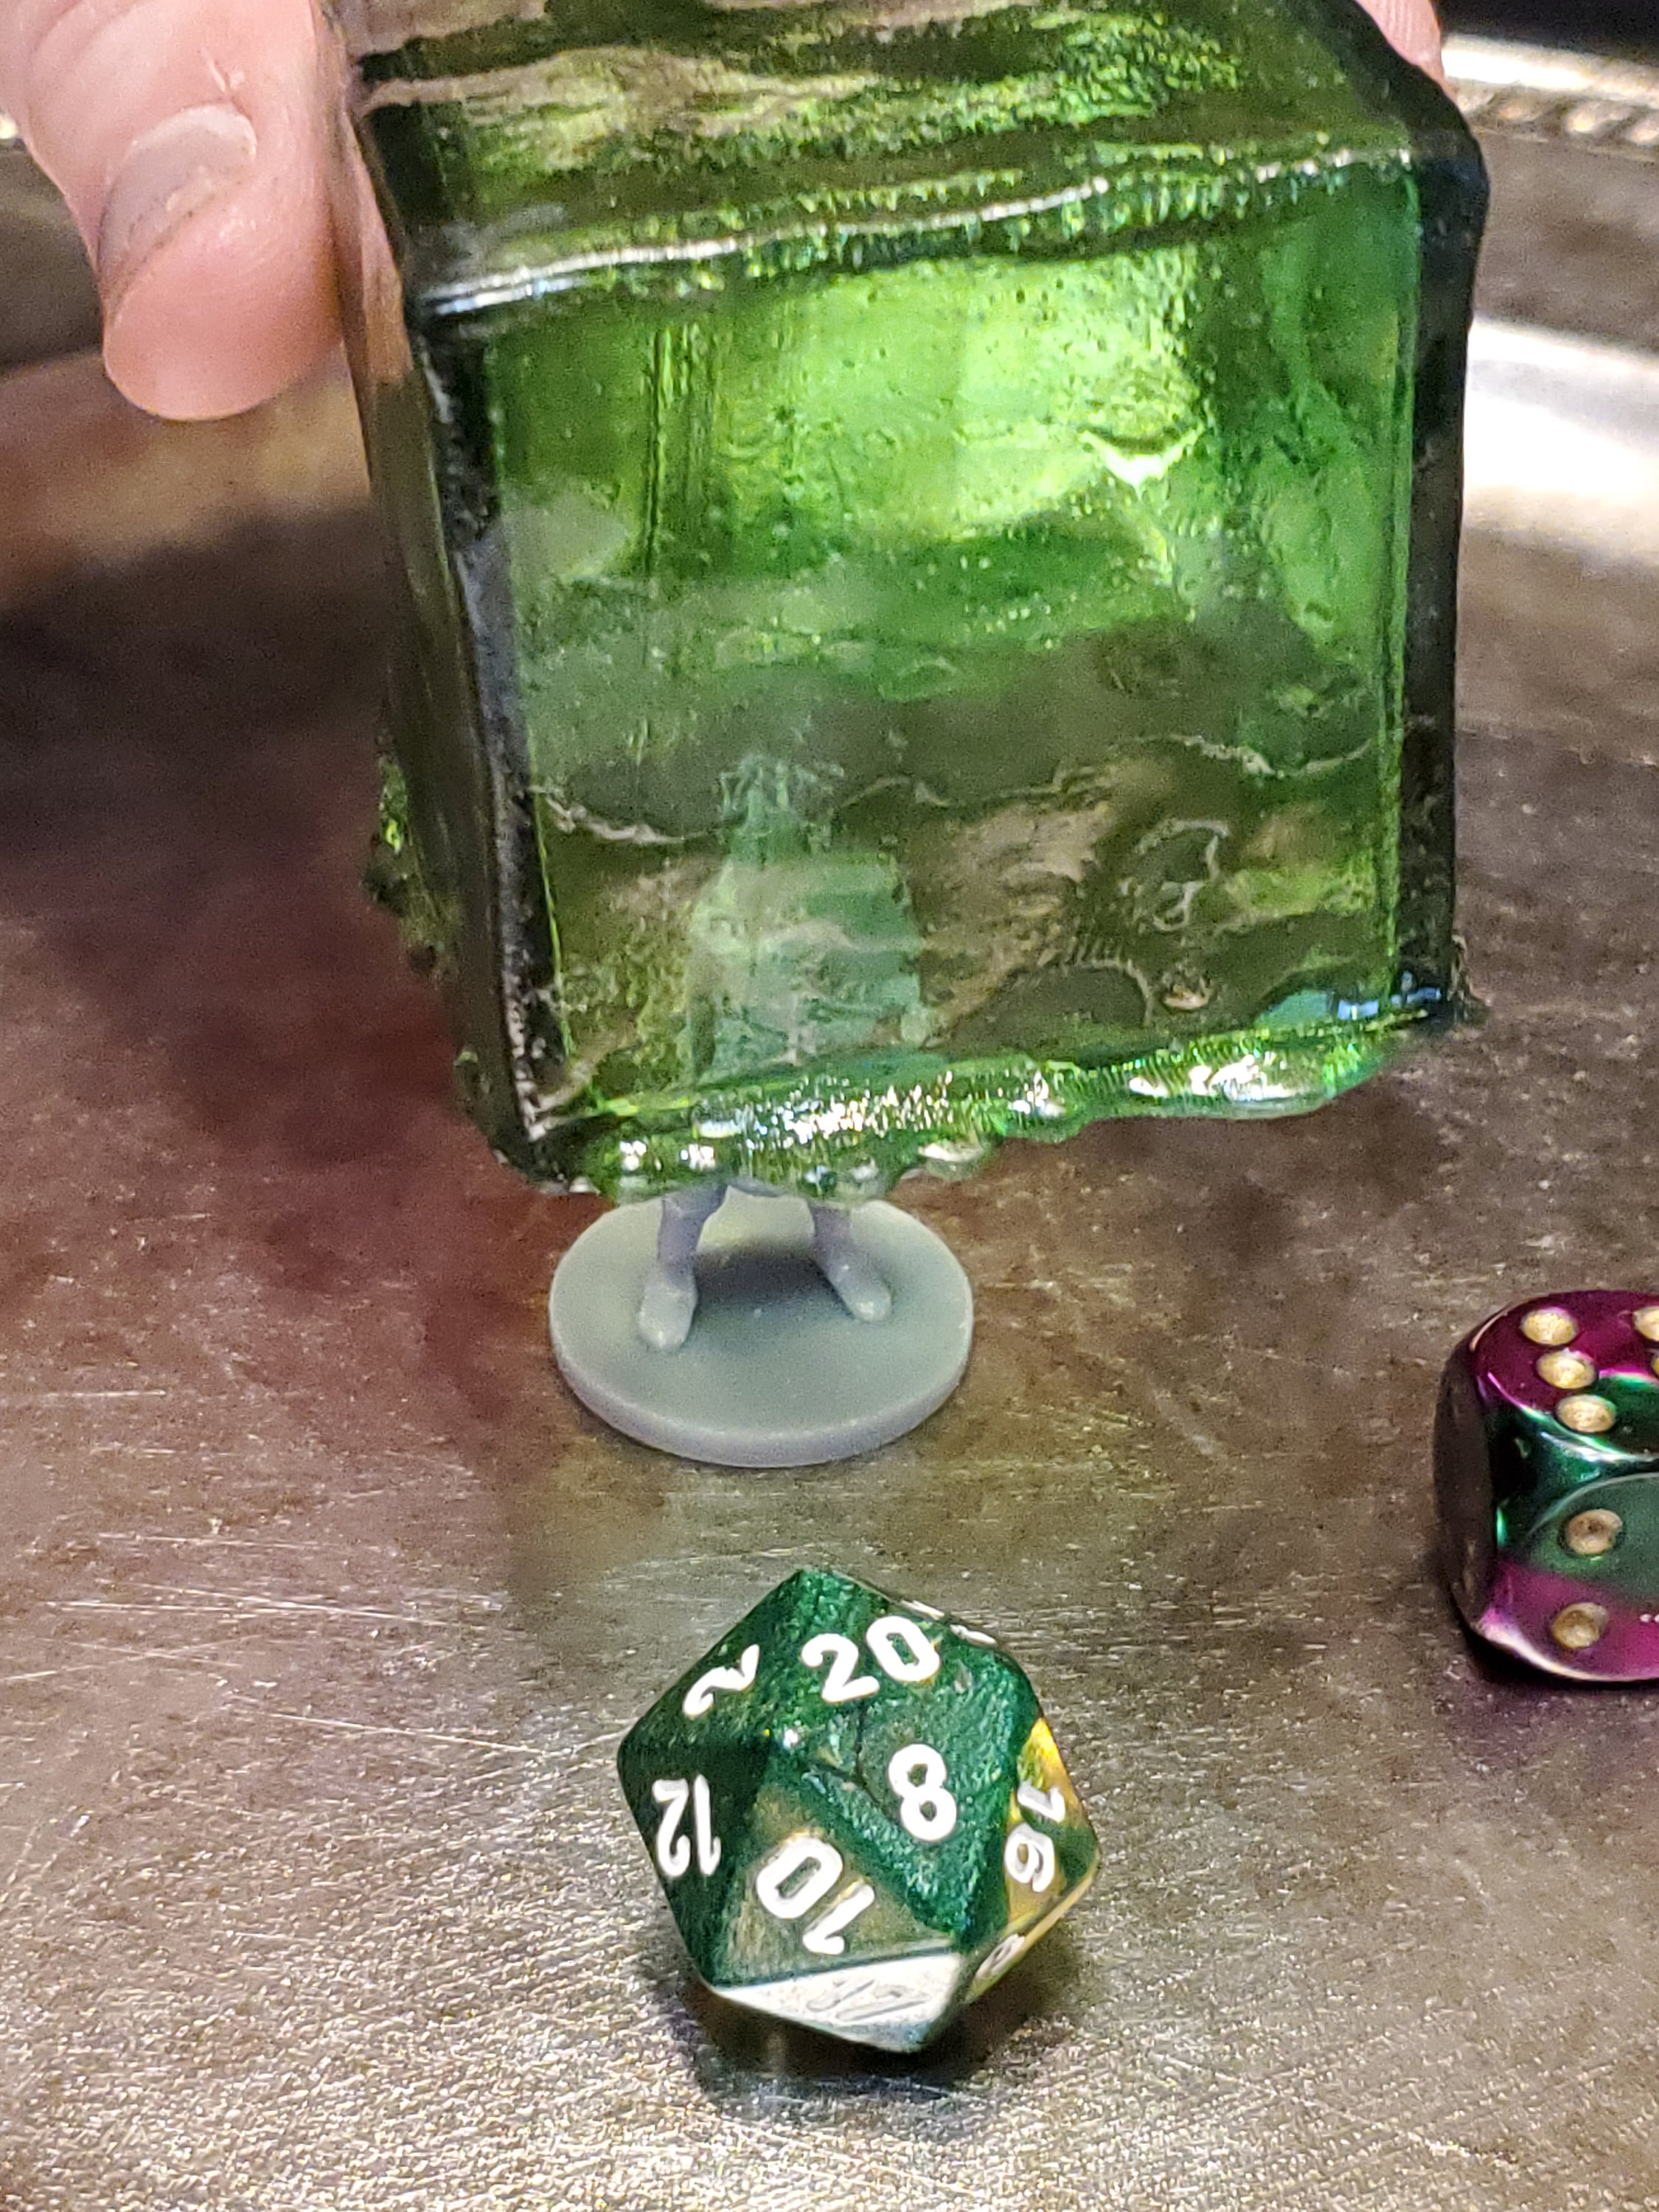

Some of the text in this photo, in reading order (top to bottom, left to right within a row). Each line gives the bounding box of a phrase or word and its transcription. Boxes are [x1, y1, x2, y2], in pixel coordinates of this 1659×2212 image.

[682, 1643, 761, 1719] 2
[801, 1615, 941, 1704] 20
[652, 1773, 722, 1878] 12
[888, 1743, 958, 1842] 8
[755, 1836, 875, 1955] 10
